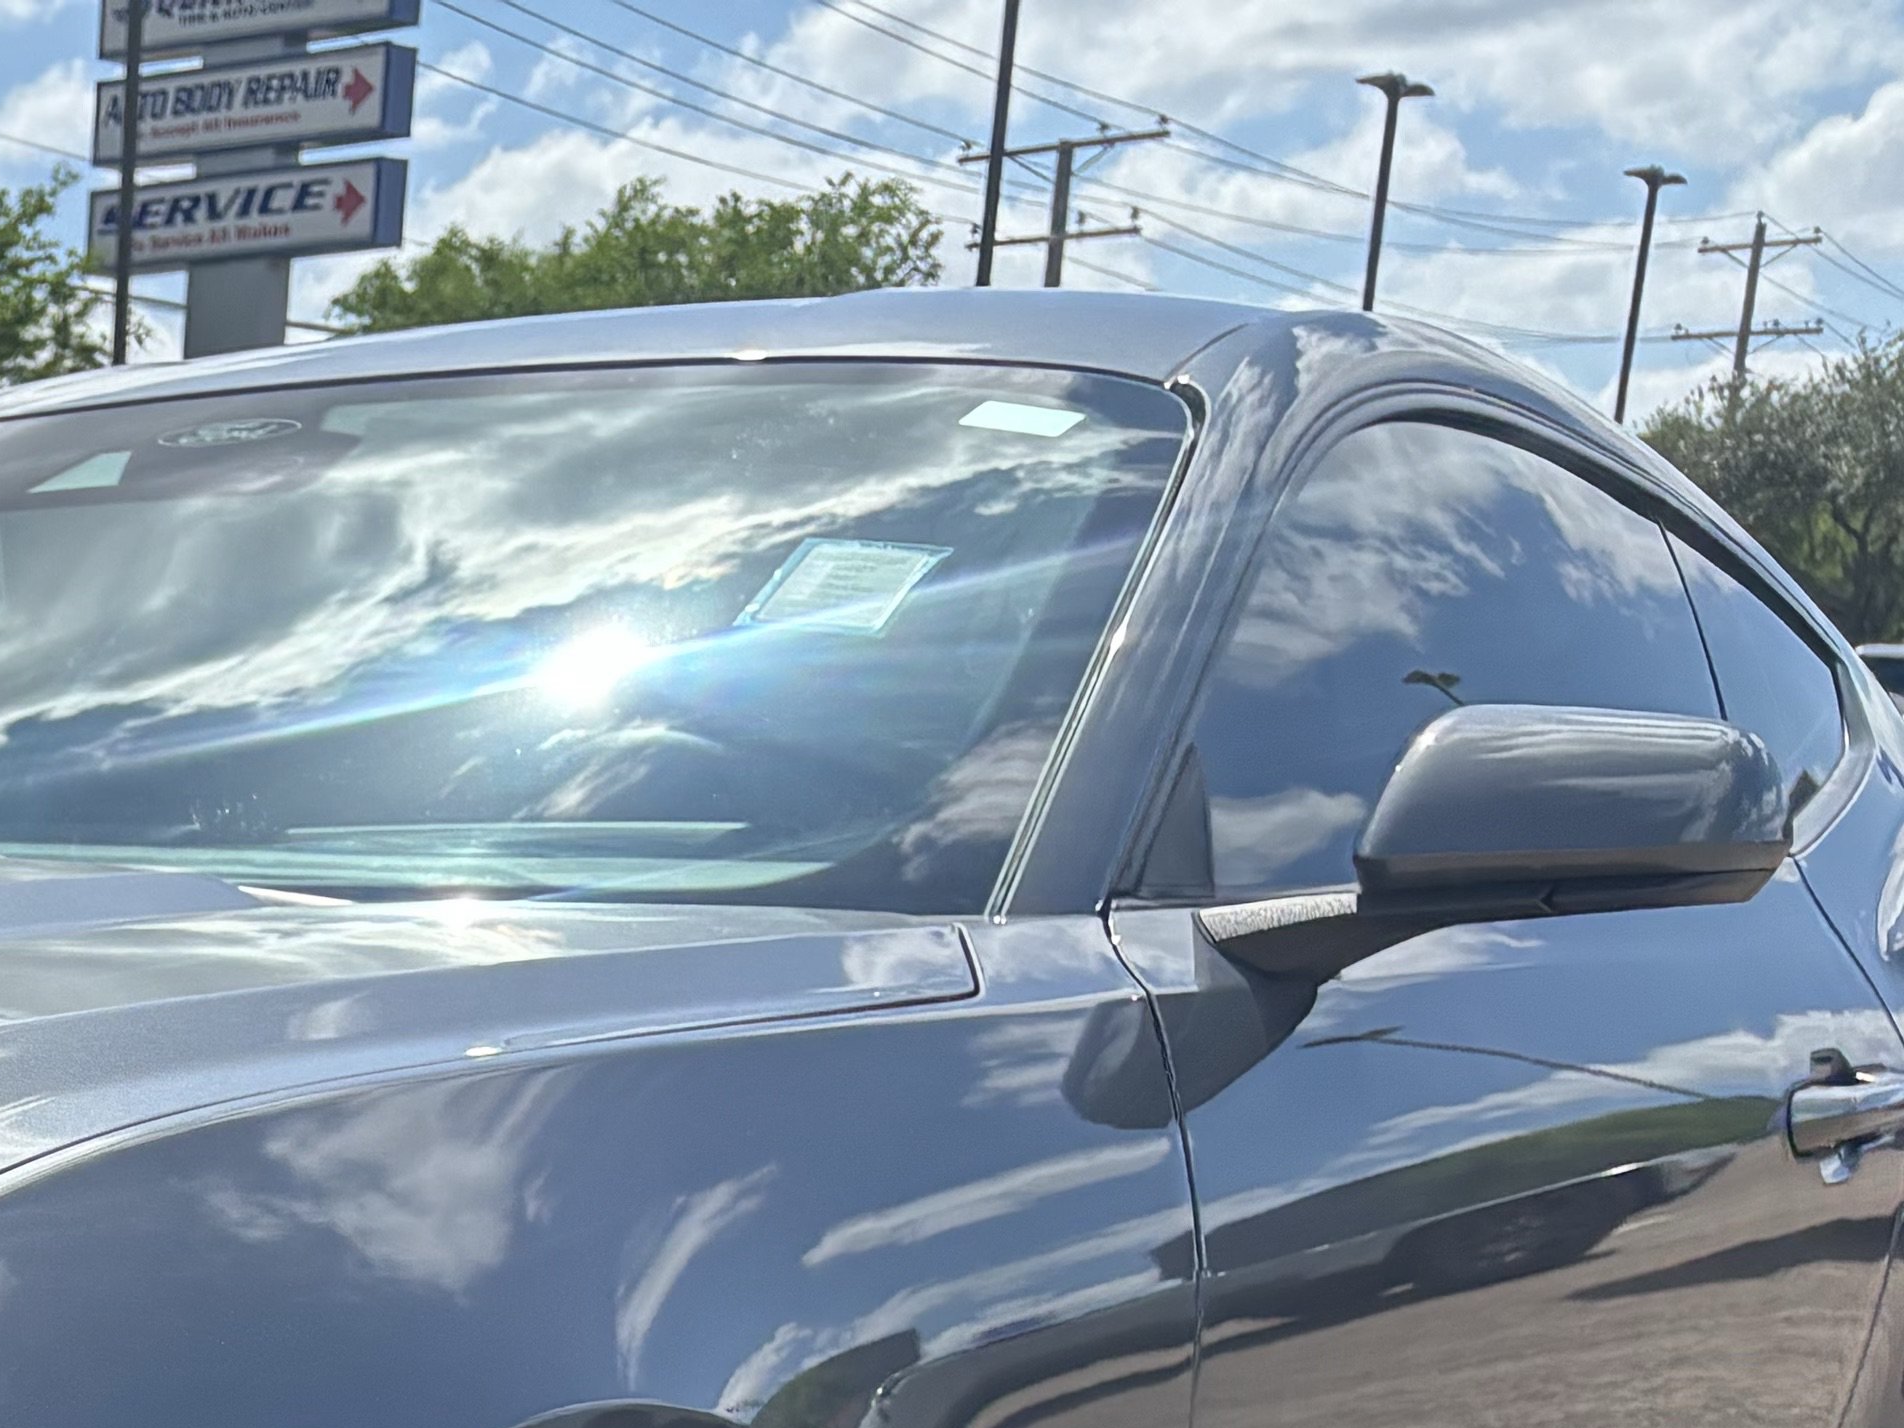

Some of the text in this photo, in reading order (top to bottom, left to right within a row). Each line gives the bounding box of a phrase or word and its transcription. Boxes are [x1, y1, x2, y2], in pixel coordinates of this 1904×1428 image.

[104, 66, 341, 127] ATO BODY REPAIR
